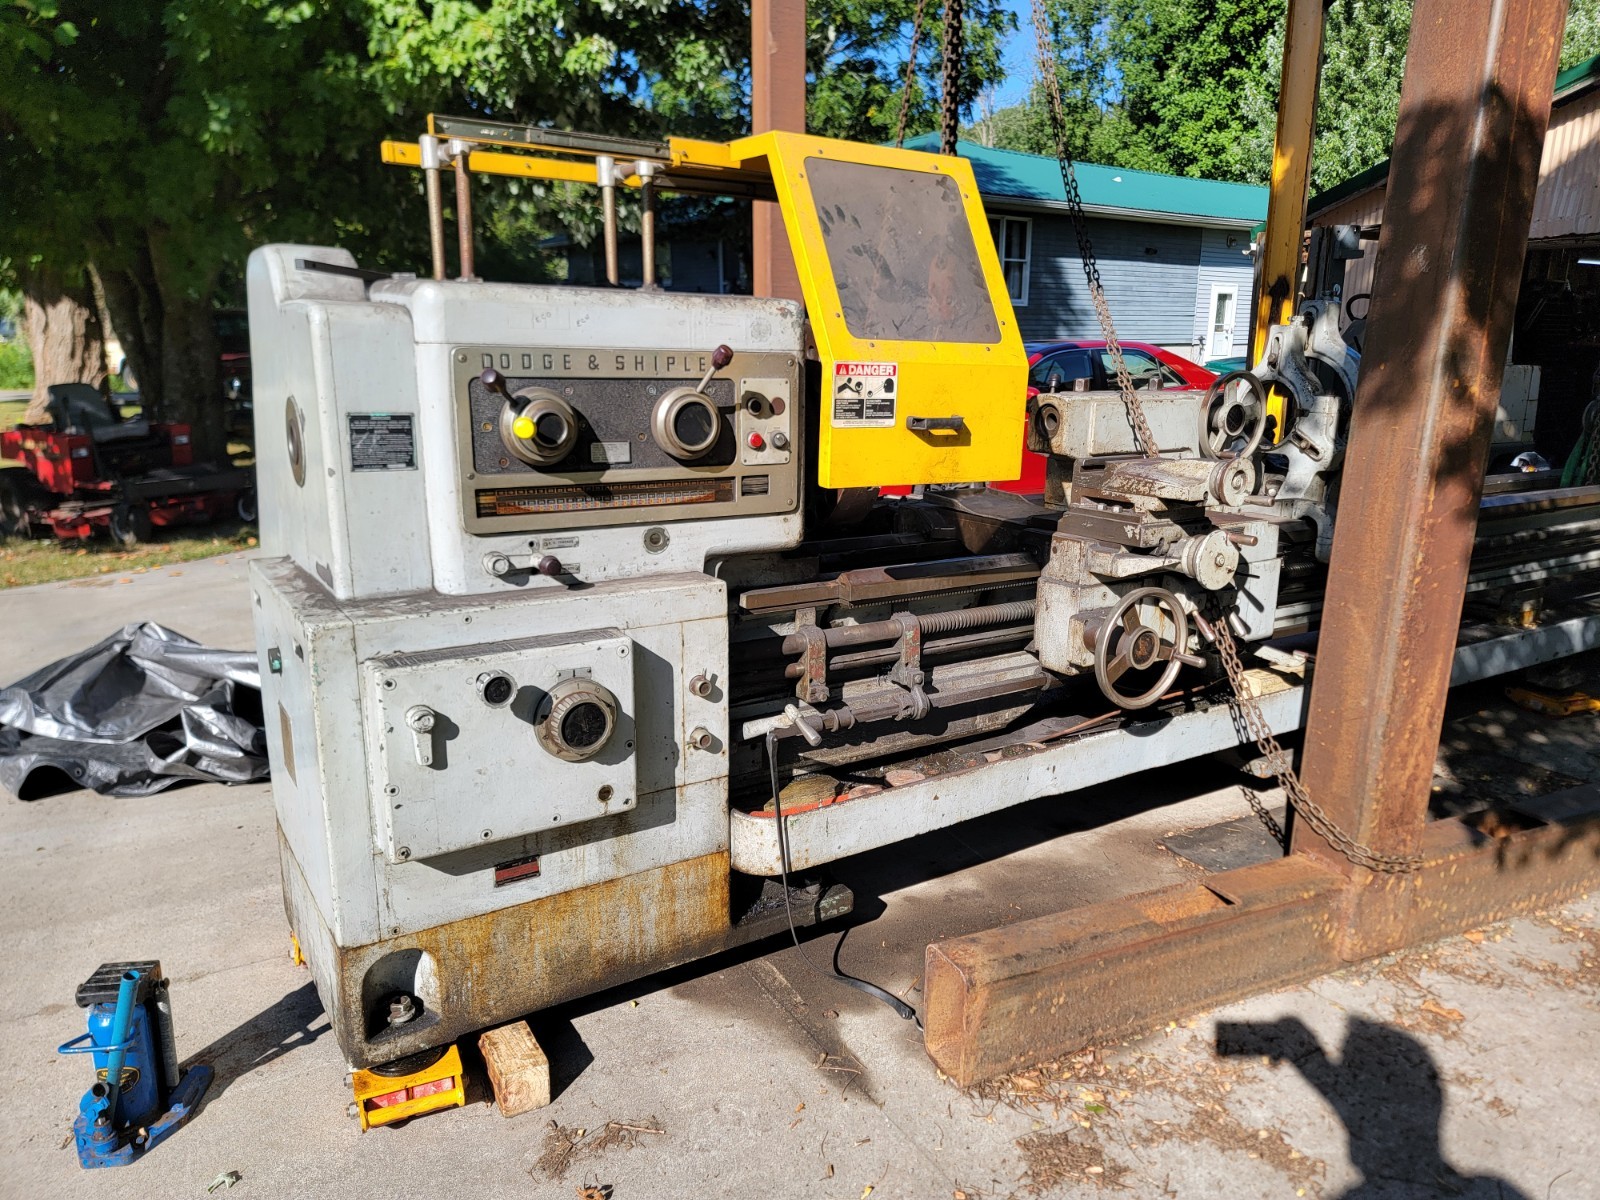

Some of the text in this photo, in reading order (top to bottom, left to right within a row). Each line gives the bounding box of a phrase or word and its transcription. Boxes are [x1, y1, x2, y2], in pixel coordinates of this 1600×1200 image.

[482, 353, 706, 372] DODGE & SHIPLE
[849, 364, 894, 376] DANGER
